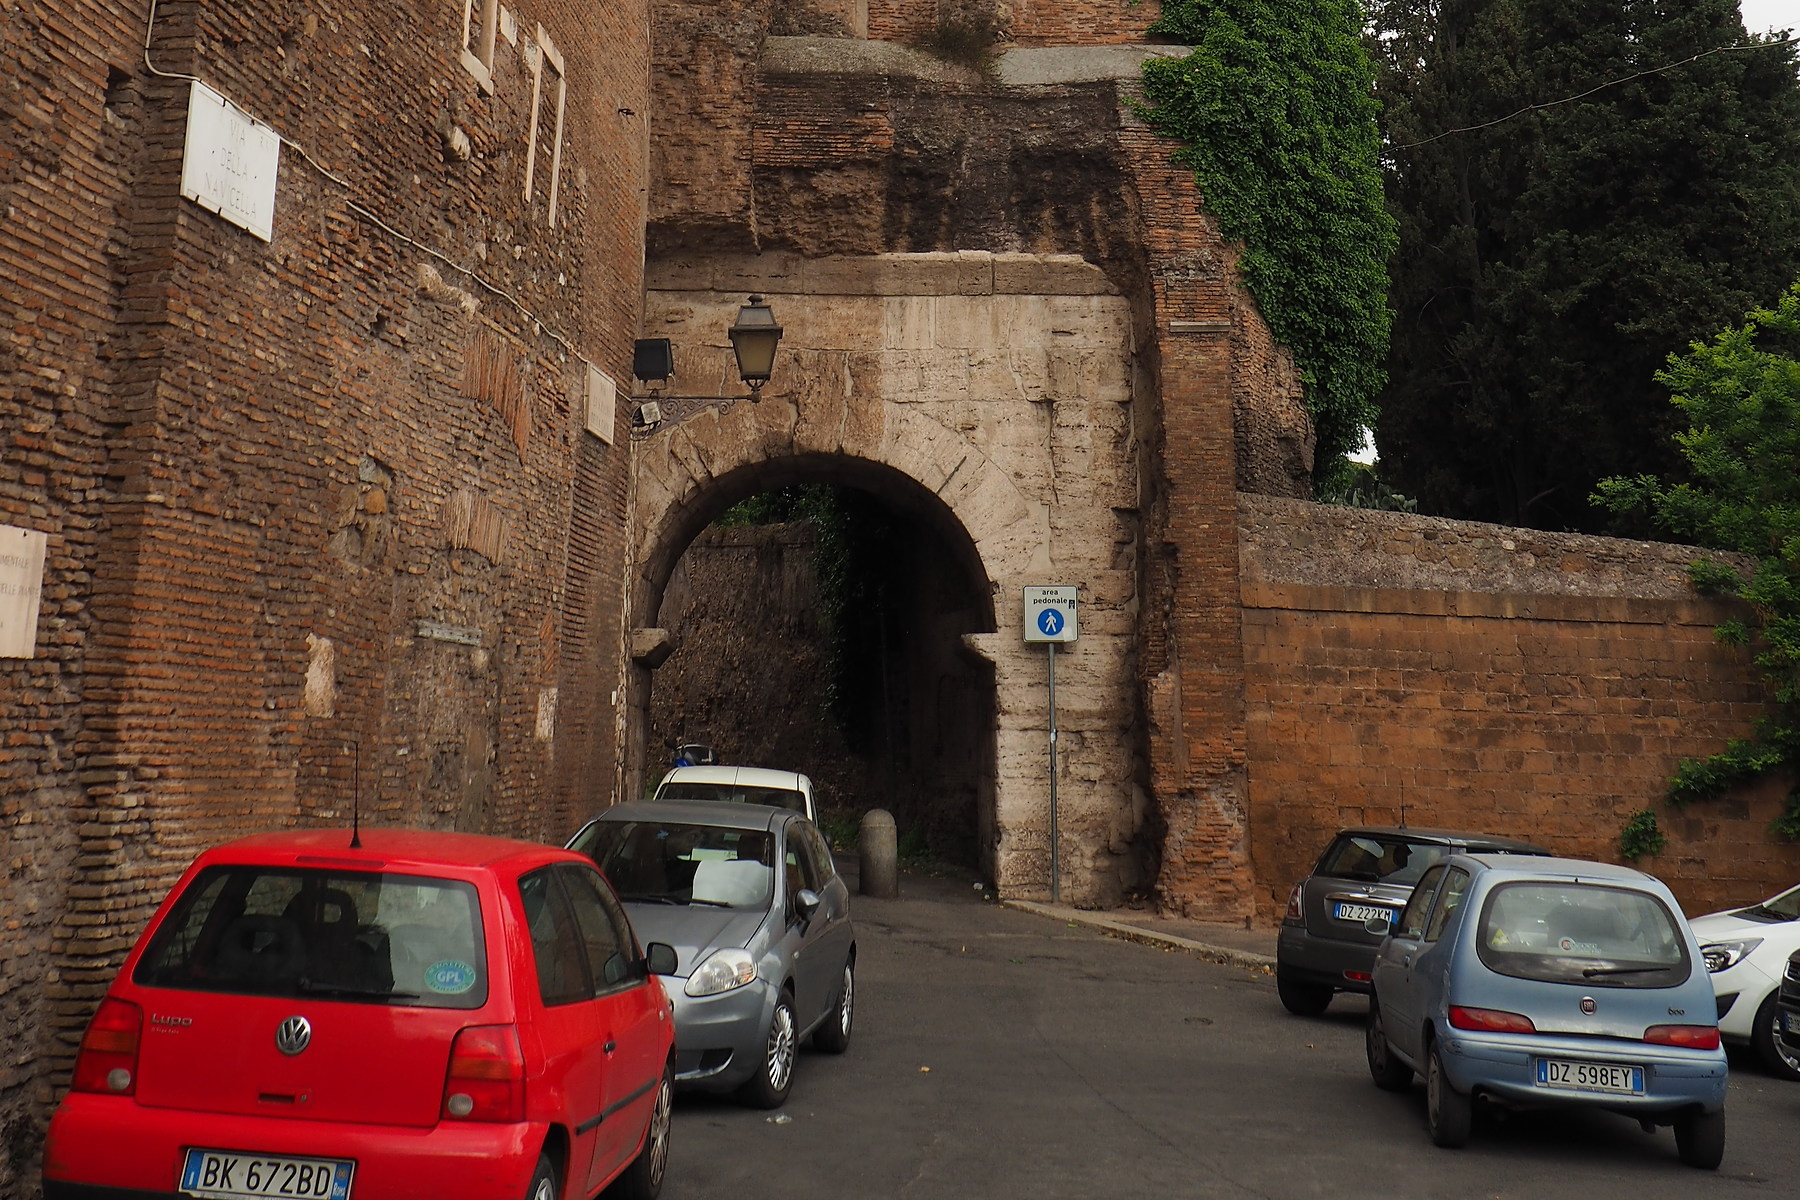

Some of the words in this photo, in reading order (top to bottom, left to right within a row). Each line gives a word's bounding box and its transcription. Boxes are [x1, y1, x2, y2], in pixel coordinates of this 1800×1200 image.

[230, 118, 246, 146] VIA
[220, 146, 248, 180] DELLA
[205, 172, 257, 218] NAVICELLA
[1033, 597, 1067, 605] pedonale
[1341, 905, 1354, 918] DZ
[437, 970, 461, 983] GPL
[152, 1013, 192, 1027] Lupo
[1550, 1063, 1571, 1083] DZ
[1578, 1066, 1630, 1088] 598EY
[203, 1156, 239, 1190] BK
[246, 1160, 331, 1196] 672BD
